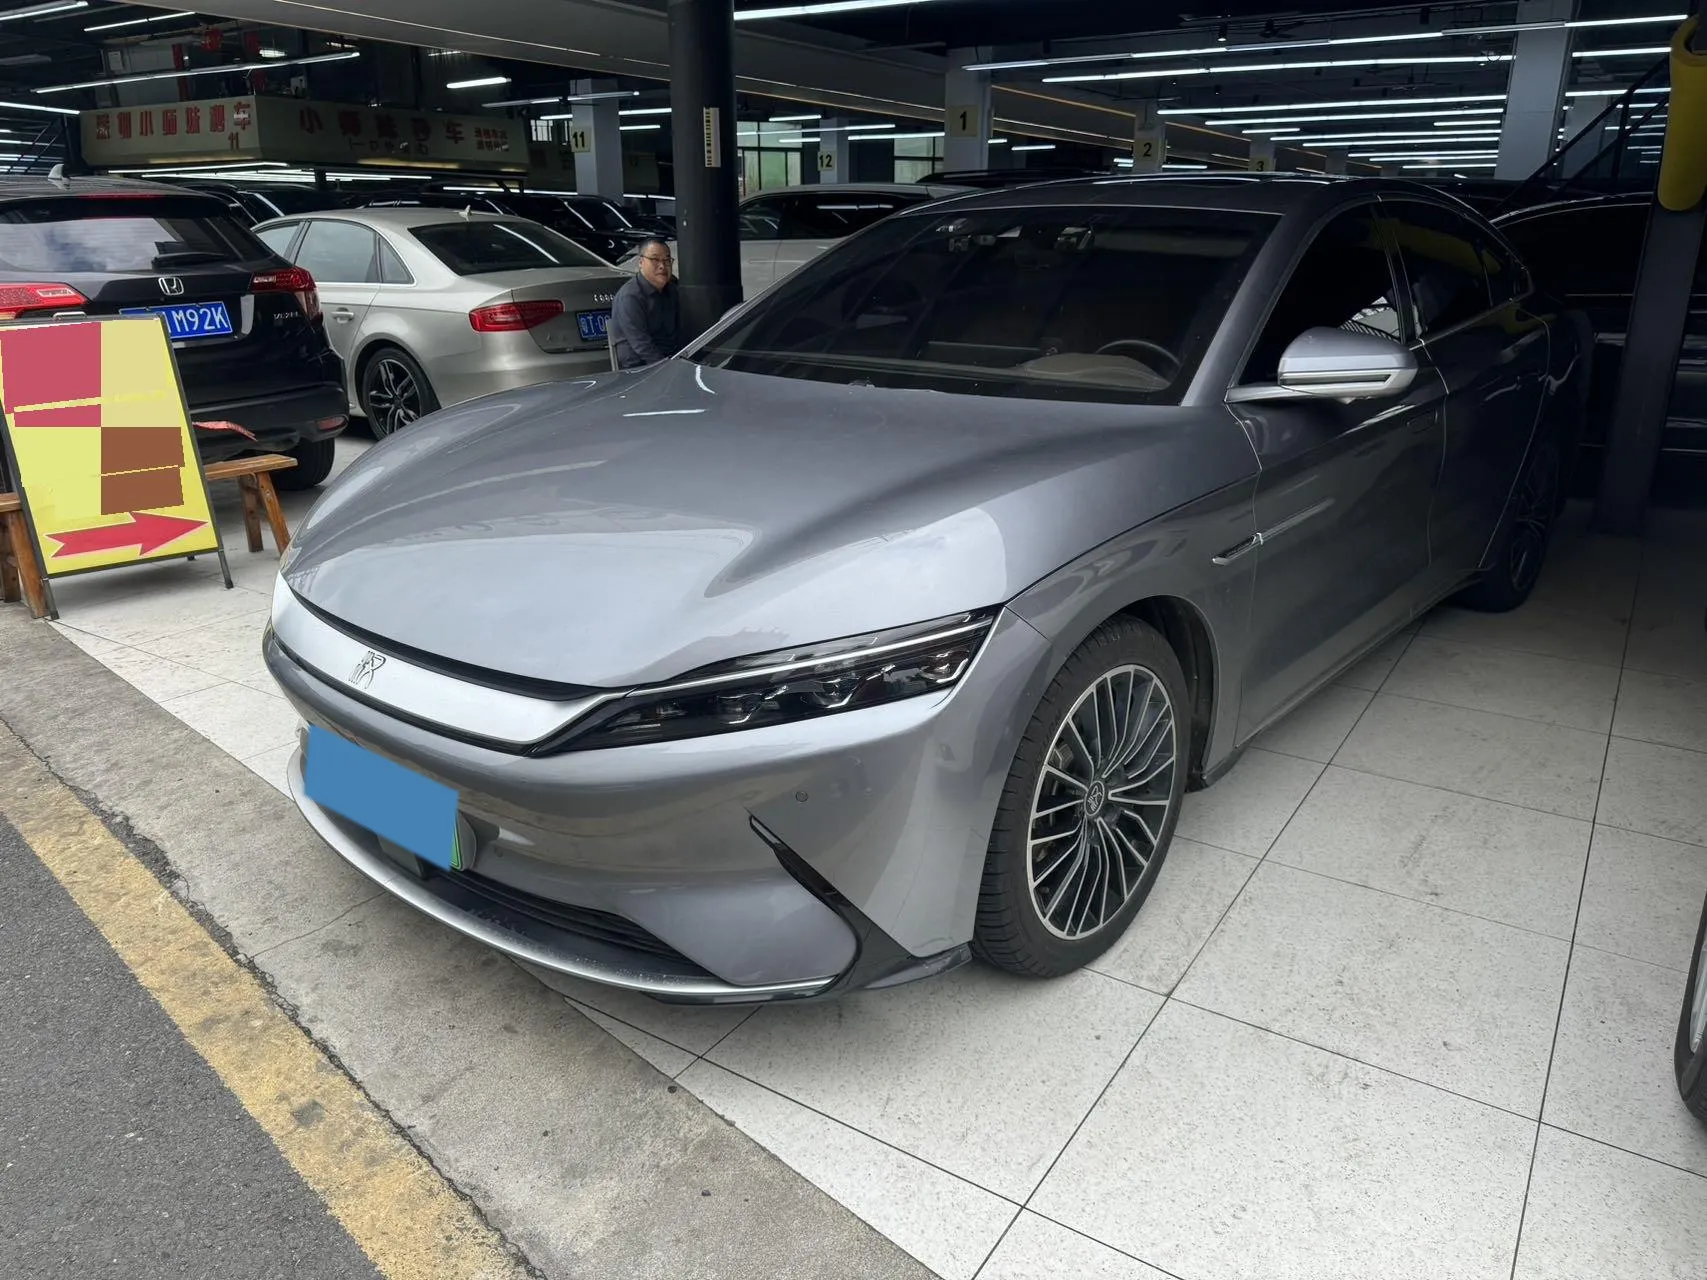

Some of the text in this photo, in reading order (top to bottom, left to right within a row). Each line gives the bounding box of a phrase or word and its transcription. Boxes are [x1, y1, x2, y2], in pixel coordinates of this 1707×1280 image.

[960, 111, 967, 131] 1
[572, 131, 585, 148] 11
[1143, 142, 1152, 157] 2
[819, 154, 833, 168] 12
[1256, 160, 1265, 172] 3
